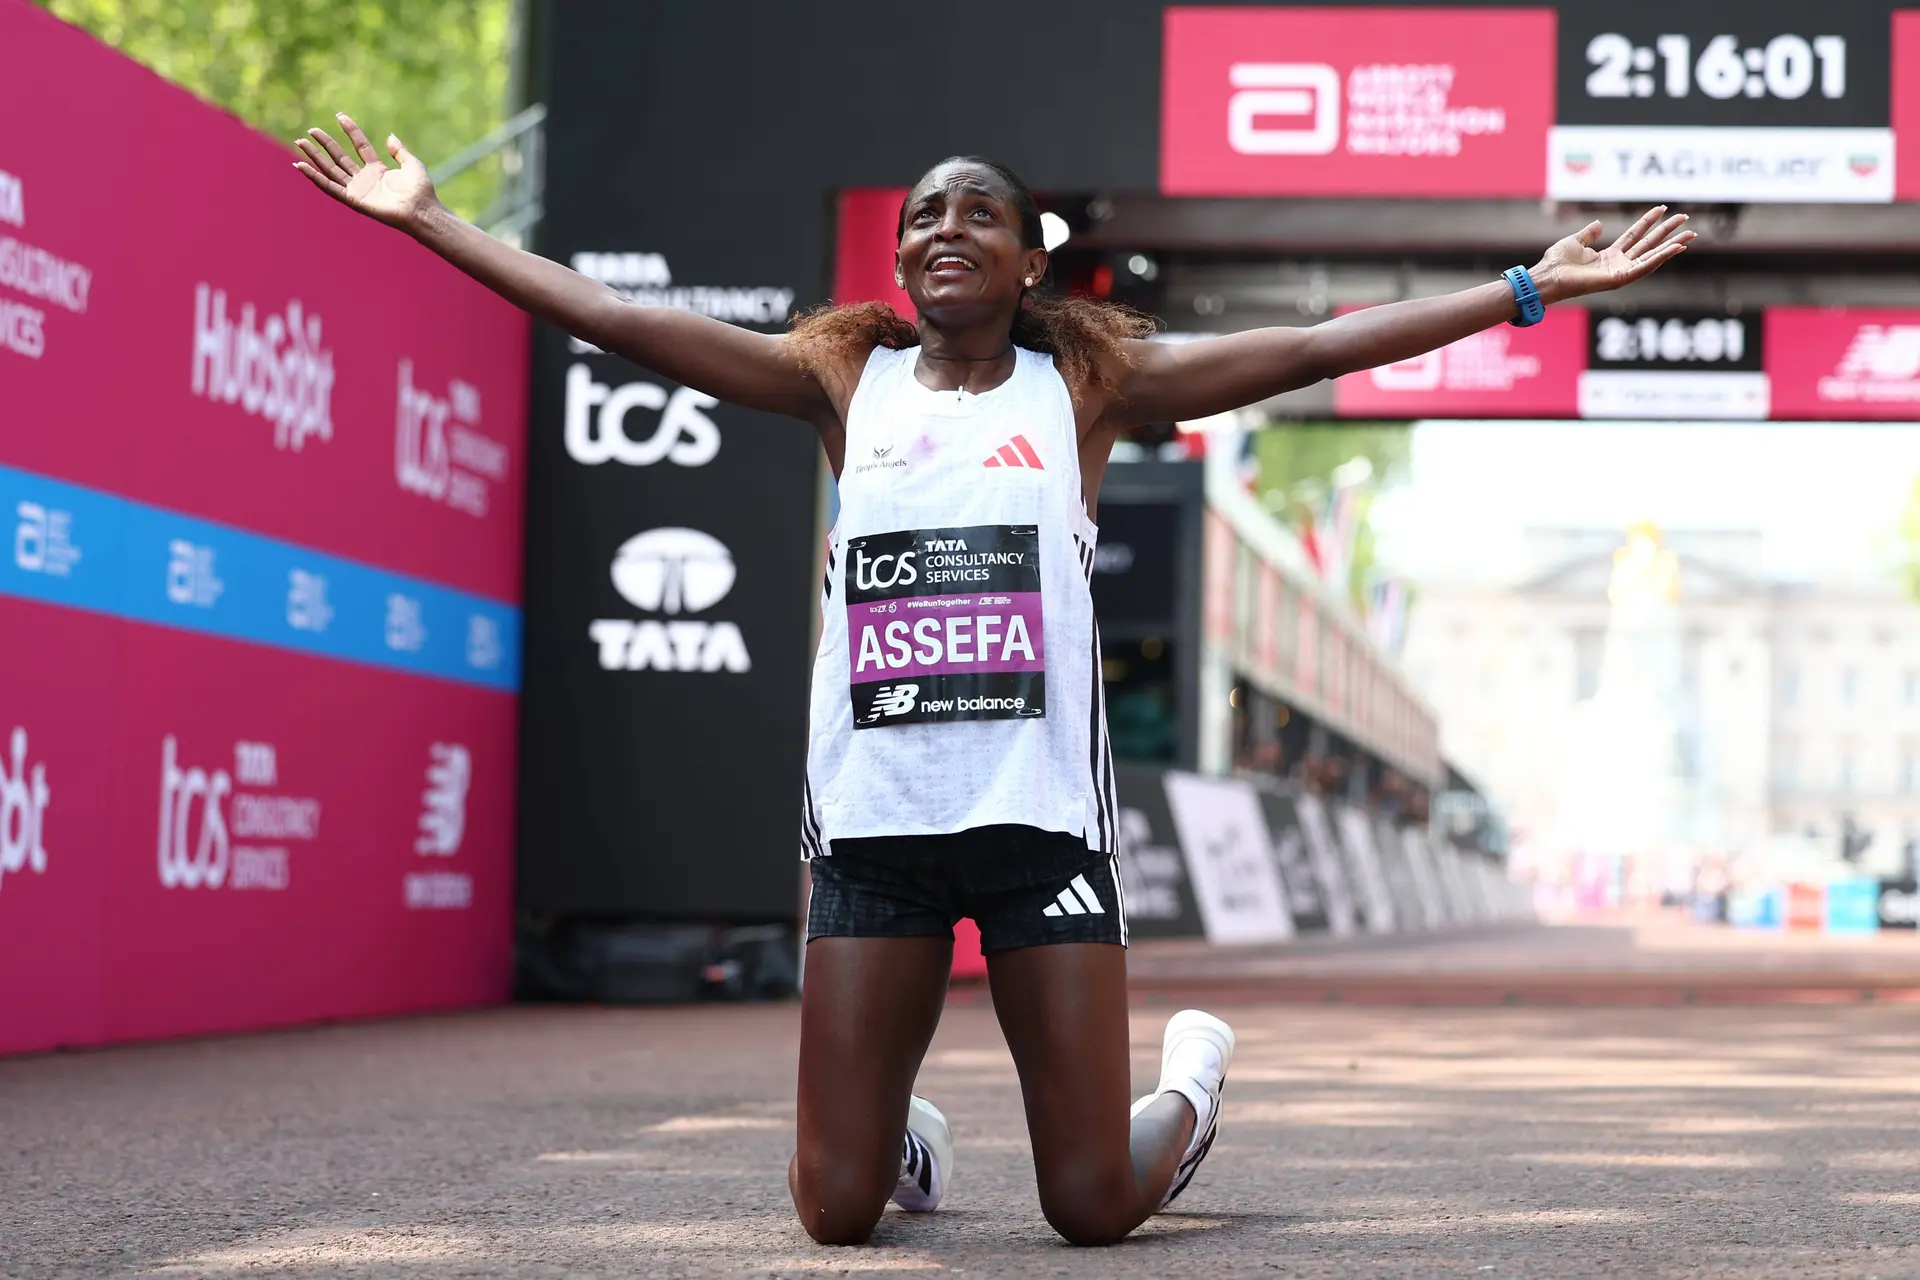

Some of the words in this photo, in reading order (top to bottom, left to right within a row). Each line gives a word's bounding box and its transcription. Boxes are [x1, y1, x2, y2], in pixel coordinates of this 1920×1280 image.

[1585, 33, 1846, 100] 2:16:01
[571, 253, 672, 287] TATA
[565, 363, 721, 467] tcs
[925, 539, 967, 553] TATA
[925, 552, 1025, 568] CONSULTANCY
[856, 549, 917, 591] tcs
[926, 568, 990, 584] SERVICES
[907, 598, 971, 609] #WeRunTogether
[588, 619, 751, 673] TATA
[856, 615, 1036, 673] ASSEFA
[921, 700, 954, 713] new
[957, 695, 1025, 711] balance
[157, 732, 232, 889] tcs
